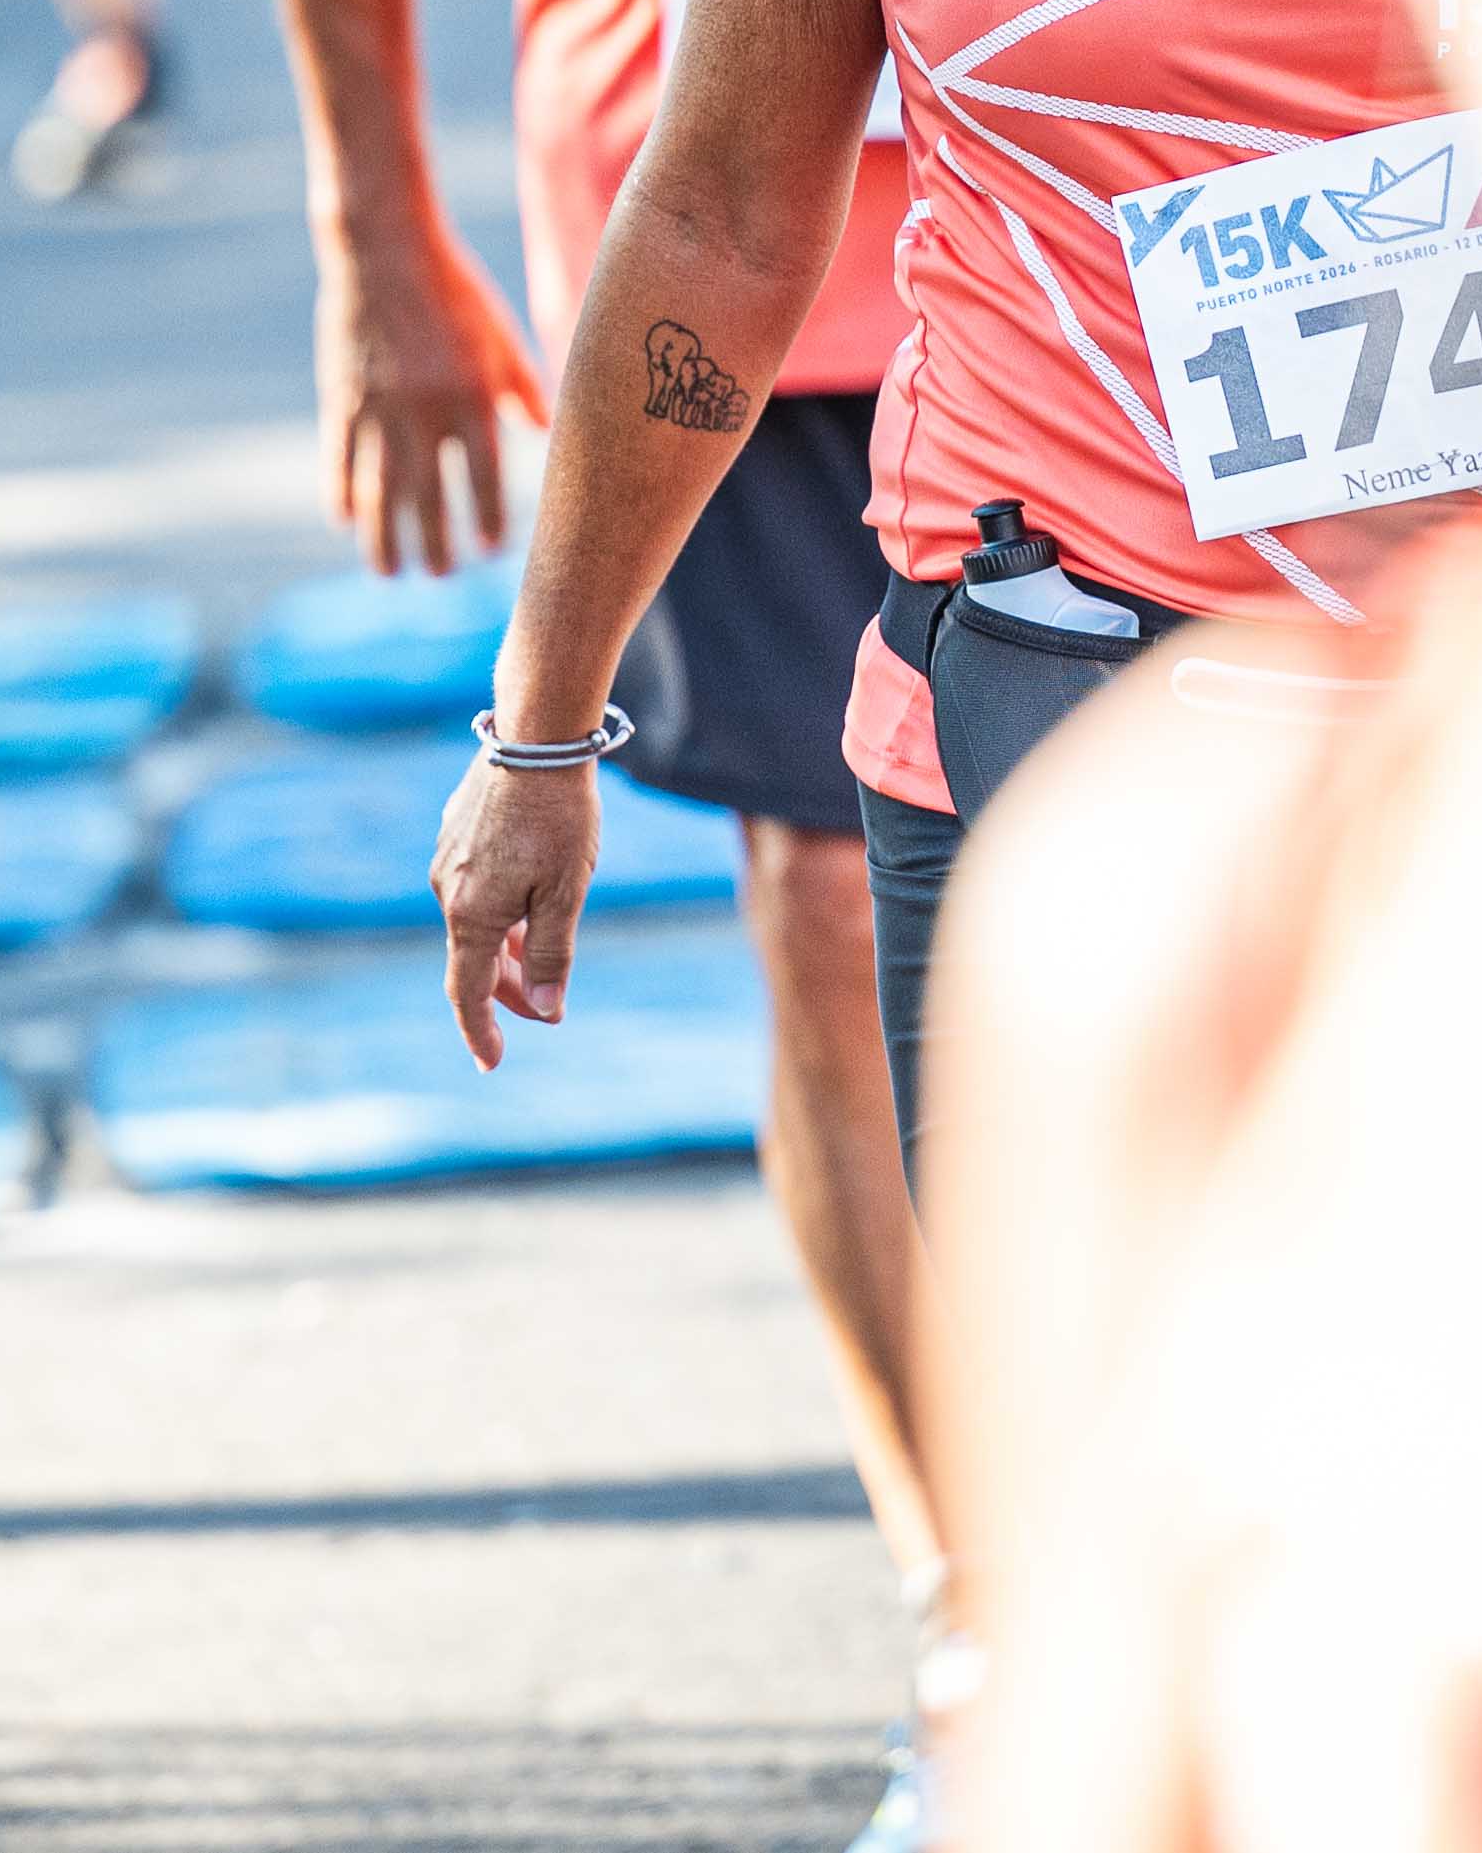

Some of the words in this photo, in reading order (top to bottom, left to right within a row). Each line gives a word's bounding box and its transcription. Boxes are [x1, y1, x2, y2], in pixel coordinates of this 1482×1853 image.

[1179, 195, 1328, 288] 15K
[1196, 287, 1258, 313] PUERTO
[1263, 274, 1315, 296] NORTE
[1319, 262, 1357, 282] 2026
[1373, 244, 1439, 269] ROSARIO
[1454, 237, 1472, 252] 12
[1343, 462, 1432, 500] Neme
